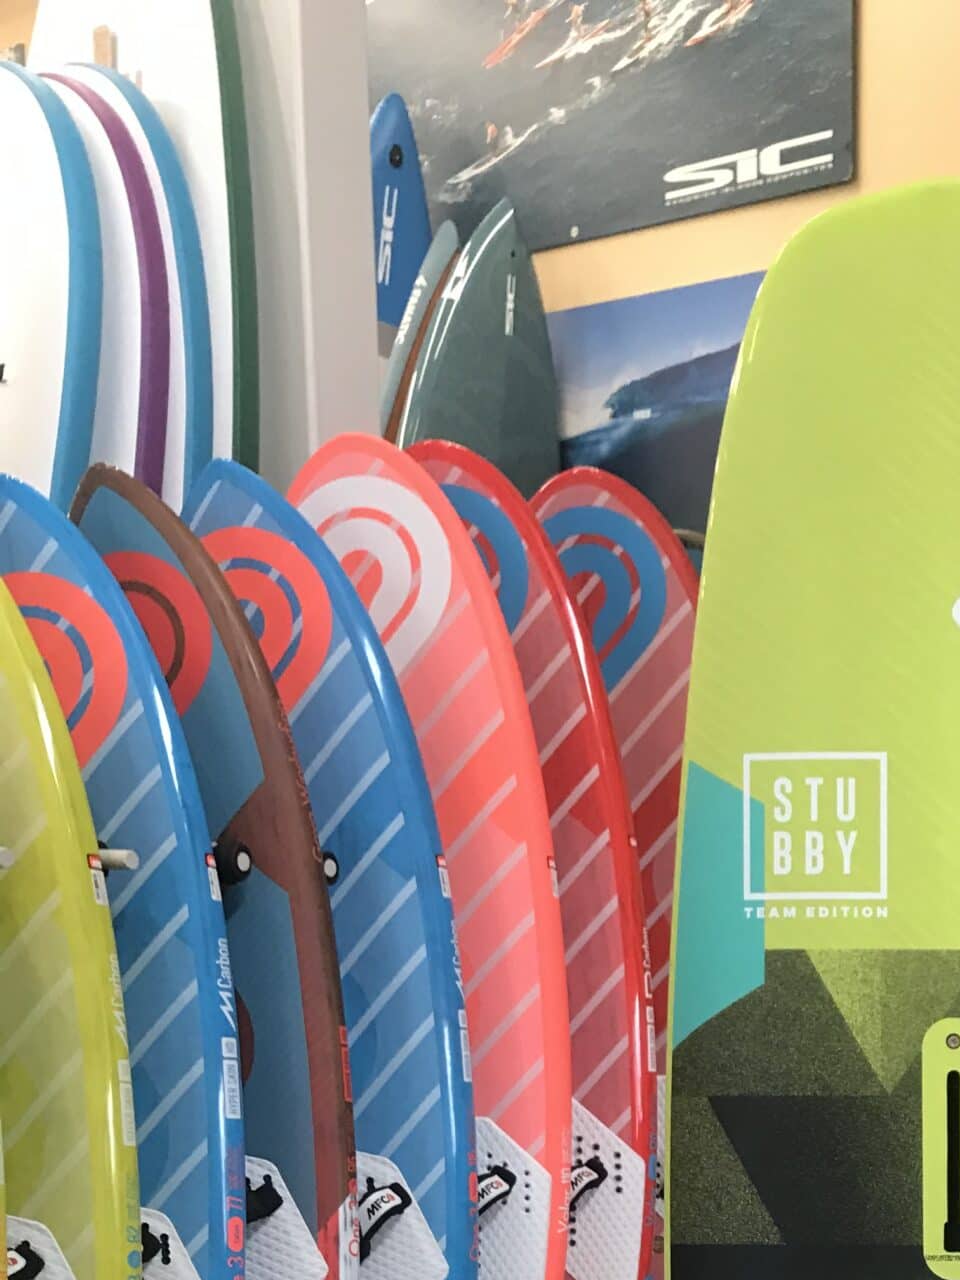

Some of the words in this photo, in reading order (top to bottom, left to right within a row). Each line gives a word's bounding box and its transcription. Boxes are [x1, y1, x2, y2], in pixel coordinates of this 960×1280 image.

[663, 129, 834, 200] SIC
[378, 184, 398, 286] SIC
[743, 906, 797, 918] TEAM
[805, 906, 889, 918] EDITION
[216, 938, 233, 990] Carbon
[227, 1195, 243, 1210] 77
[366, 1194, 391, 1221] MFC
[227, 1256, 244, 1268] 3
